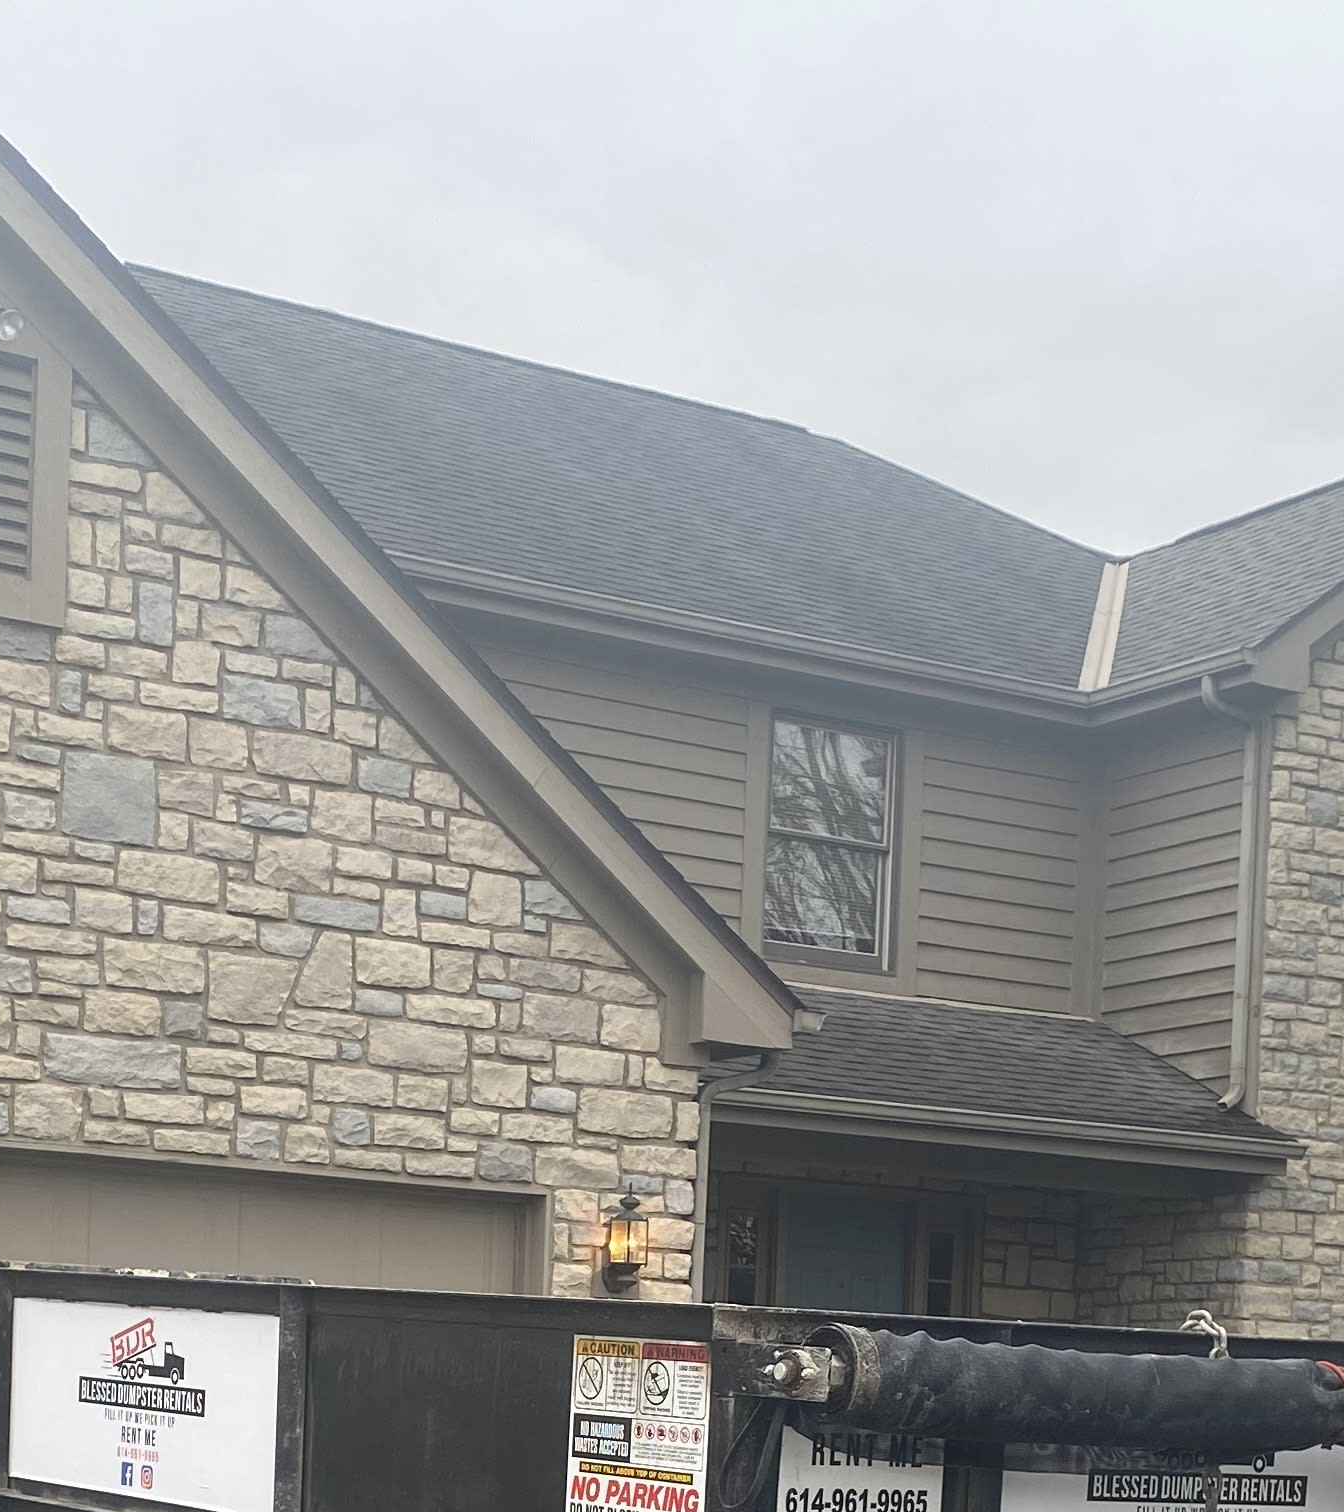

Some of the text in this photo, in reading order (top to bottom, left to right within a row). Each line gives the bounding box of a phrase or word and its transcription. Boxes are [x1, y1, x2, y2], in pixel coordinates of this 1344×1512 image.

[590, 1342, 635, 1356] CAUTION
[655, 1345, 705, 1361] WARNING
[81, 1379, 203, 1414] BLESSED DUMPSTER RENTALS
[121, 1426, 156, 1446] RENT ME
[580, 1420, 625, 1440] NO HAZARDOUS
[574, 1436, 598, 1453] WASTES
[598, 1440, 629, 1457] ACCEPTED
[811, 1432, 924, 1468] RENT ME
[570, 1475, 601, 1502] NO
[1093, 1474, 1303, 1503] BLESSED DUMPER RENTALS
